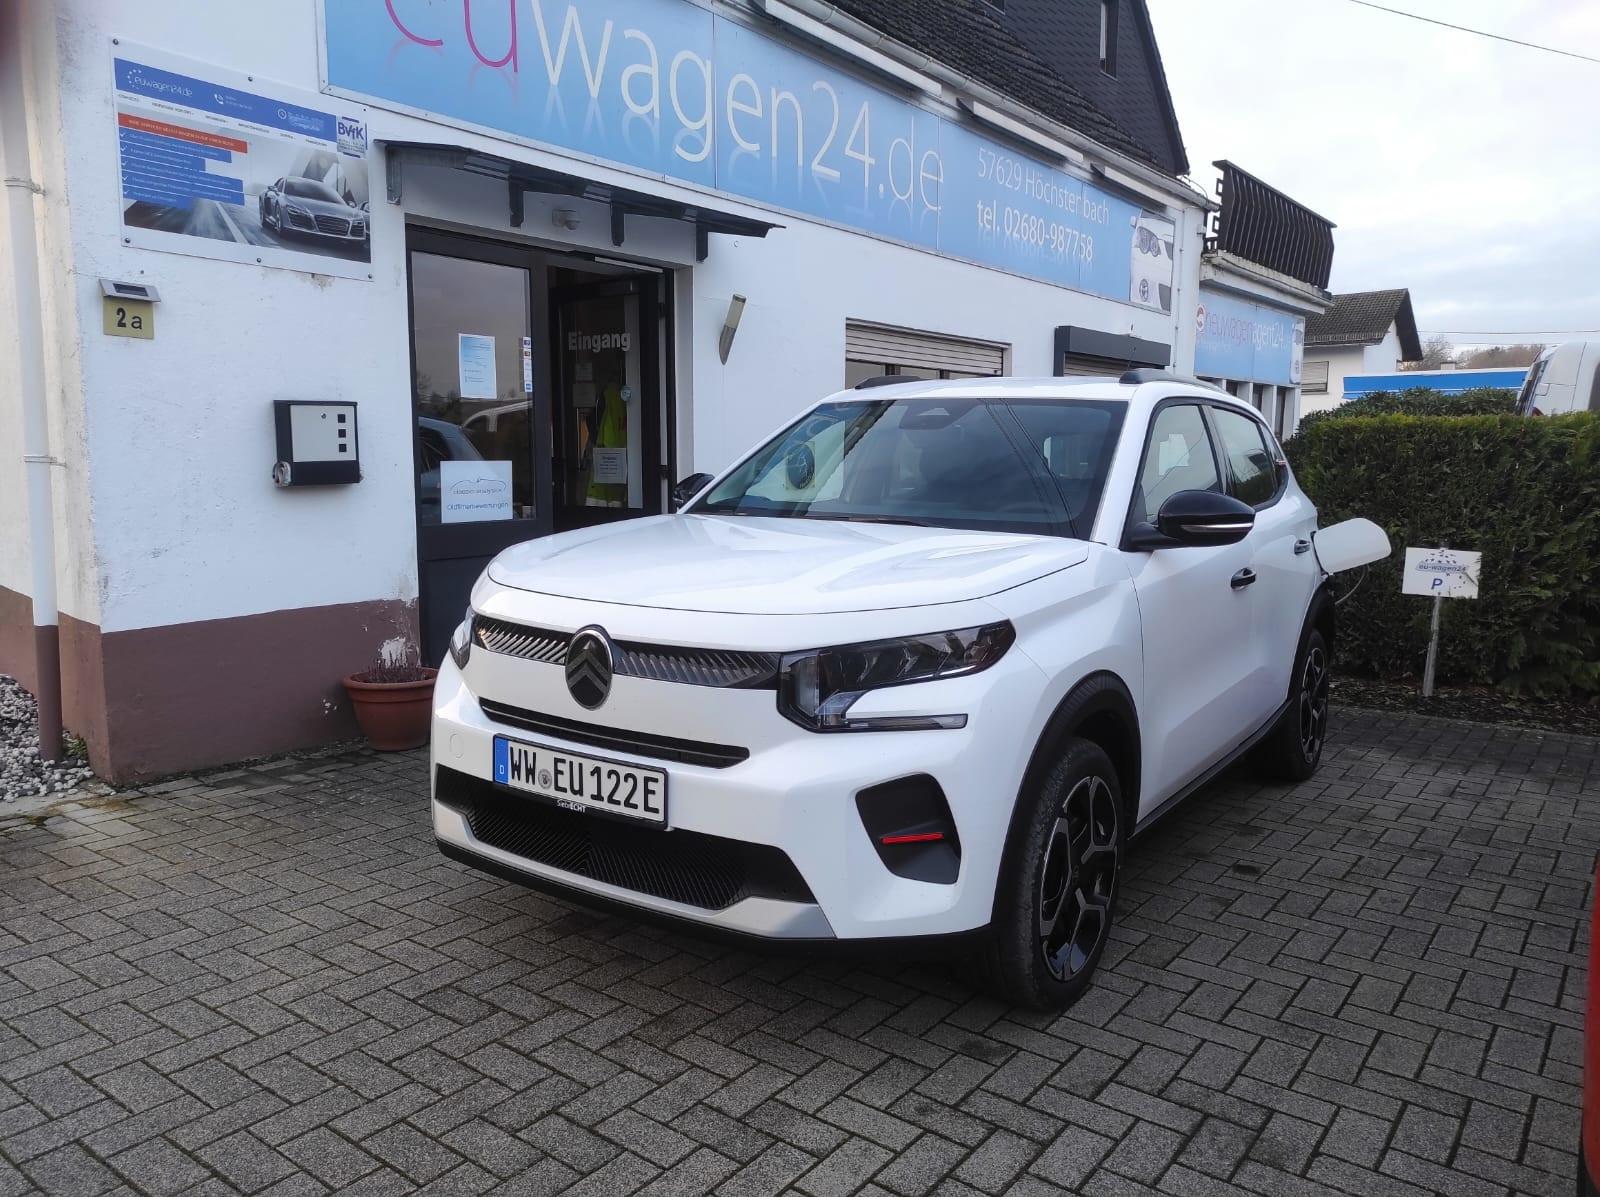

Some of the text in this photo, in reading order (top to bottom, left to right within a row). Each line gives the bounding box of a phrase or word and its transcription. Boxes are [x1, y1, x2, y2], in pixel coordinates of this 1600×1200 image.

[977, 147, 1022, 191] 57629
[976, 199, 1094, 262] tel. 02680-987758
[116, 307, 143, 330] 2 a
[568, 331, 632, 353] Eingang
[1431, 578, 1443, 590] P
[509, 746, 537, 786] WW
[553, 756, 584, 797] EU
[590, 766, 660, 815] 122E
